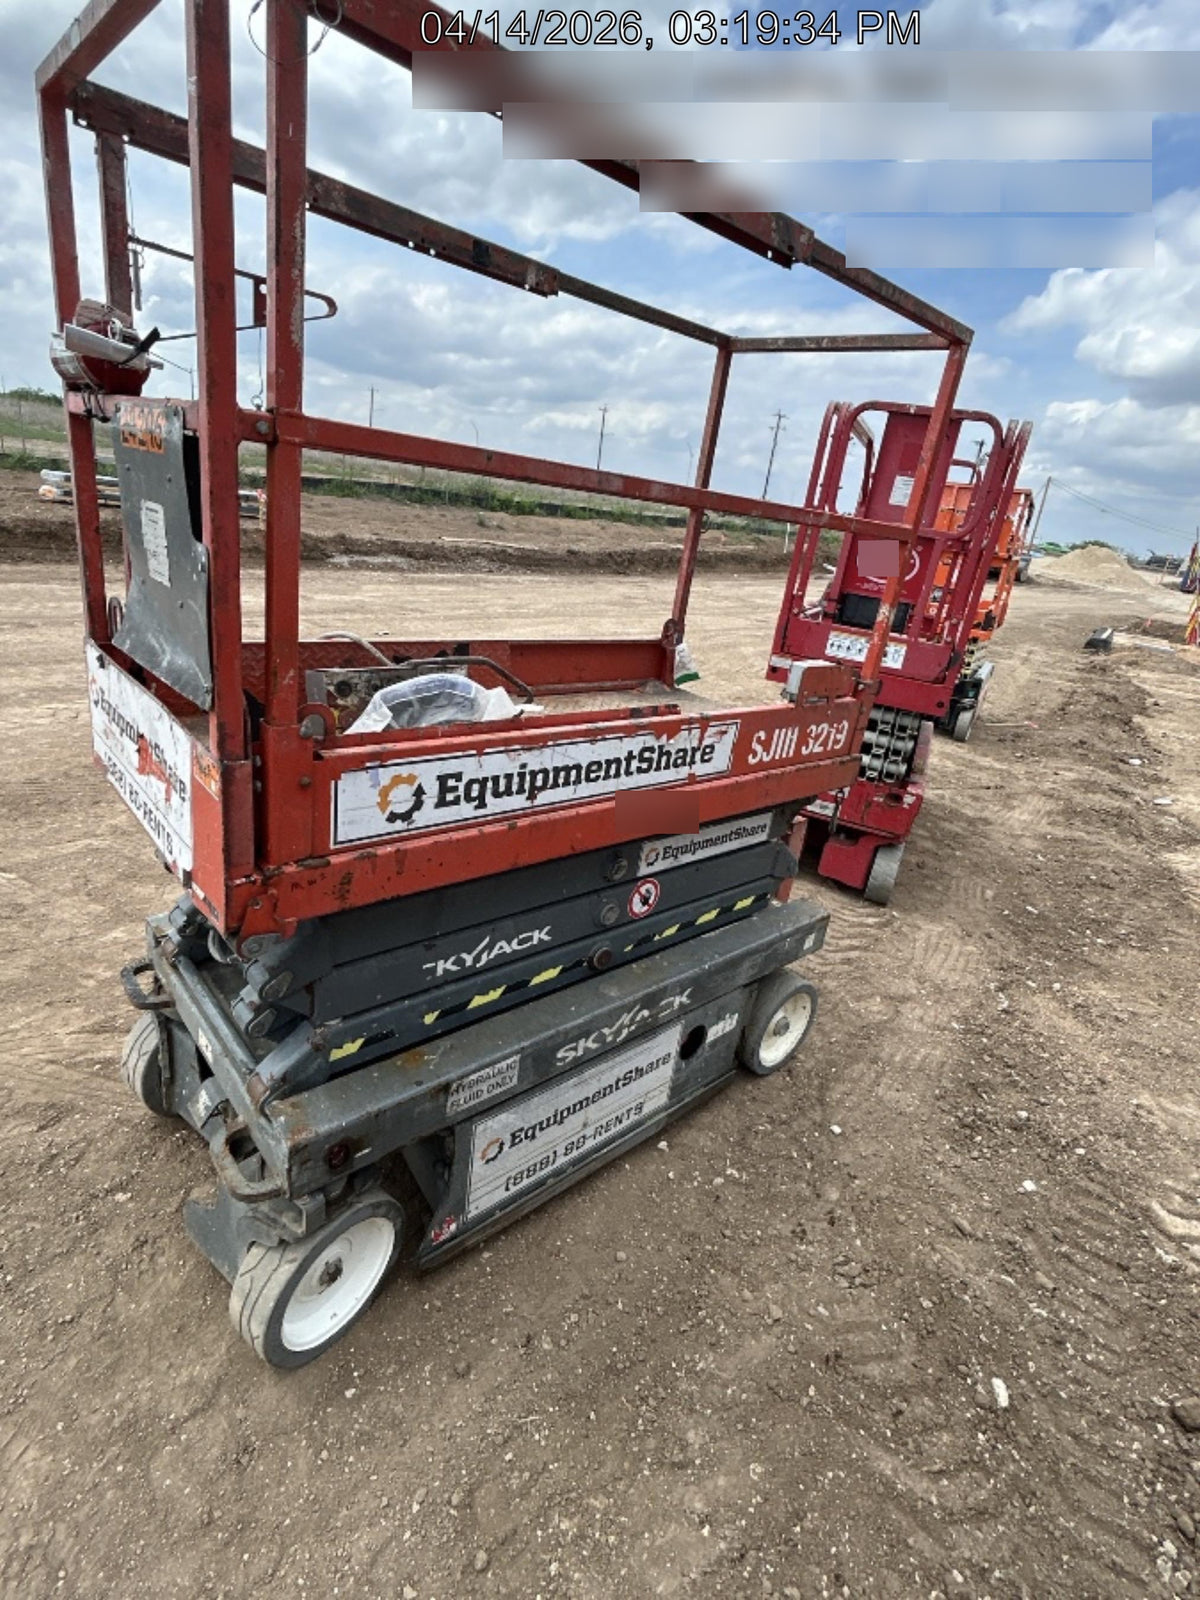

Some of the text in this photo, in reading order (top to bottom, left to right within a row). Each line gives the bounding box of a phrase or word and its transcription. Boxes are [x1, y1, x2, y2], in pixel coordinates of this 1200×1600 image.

[434, 742, 716, 810] EquipmentShare
[661, 823, 767, 862] EquipmentShare
[508, 1051, 672, 1149] EquipmentShare
[504, 1100, 646, 1192] (888) 88-RENTS
